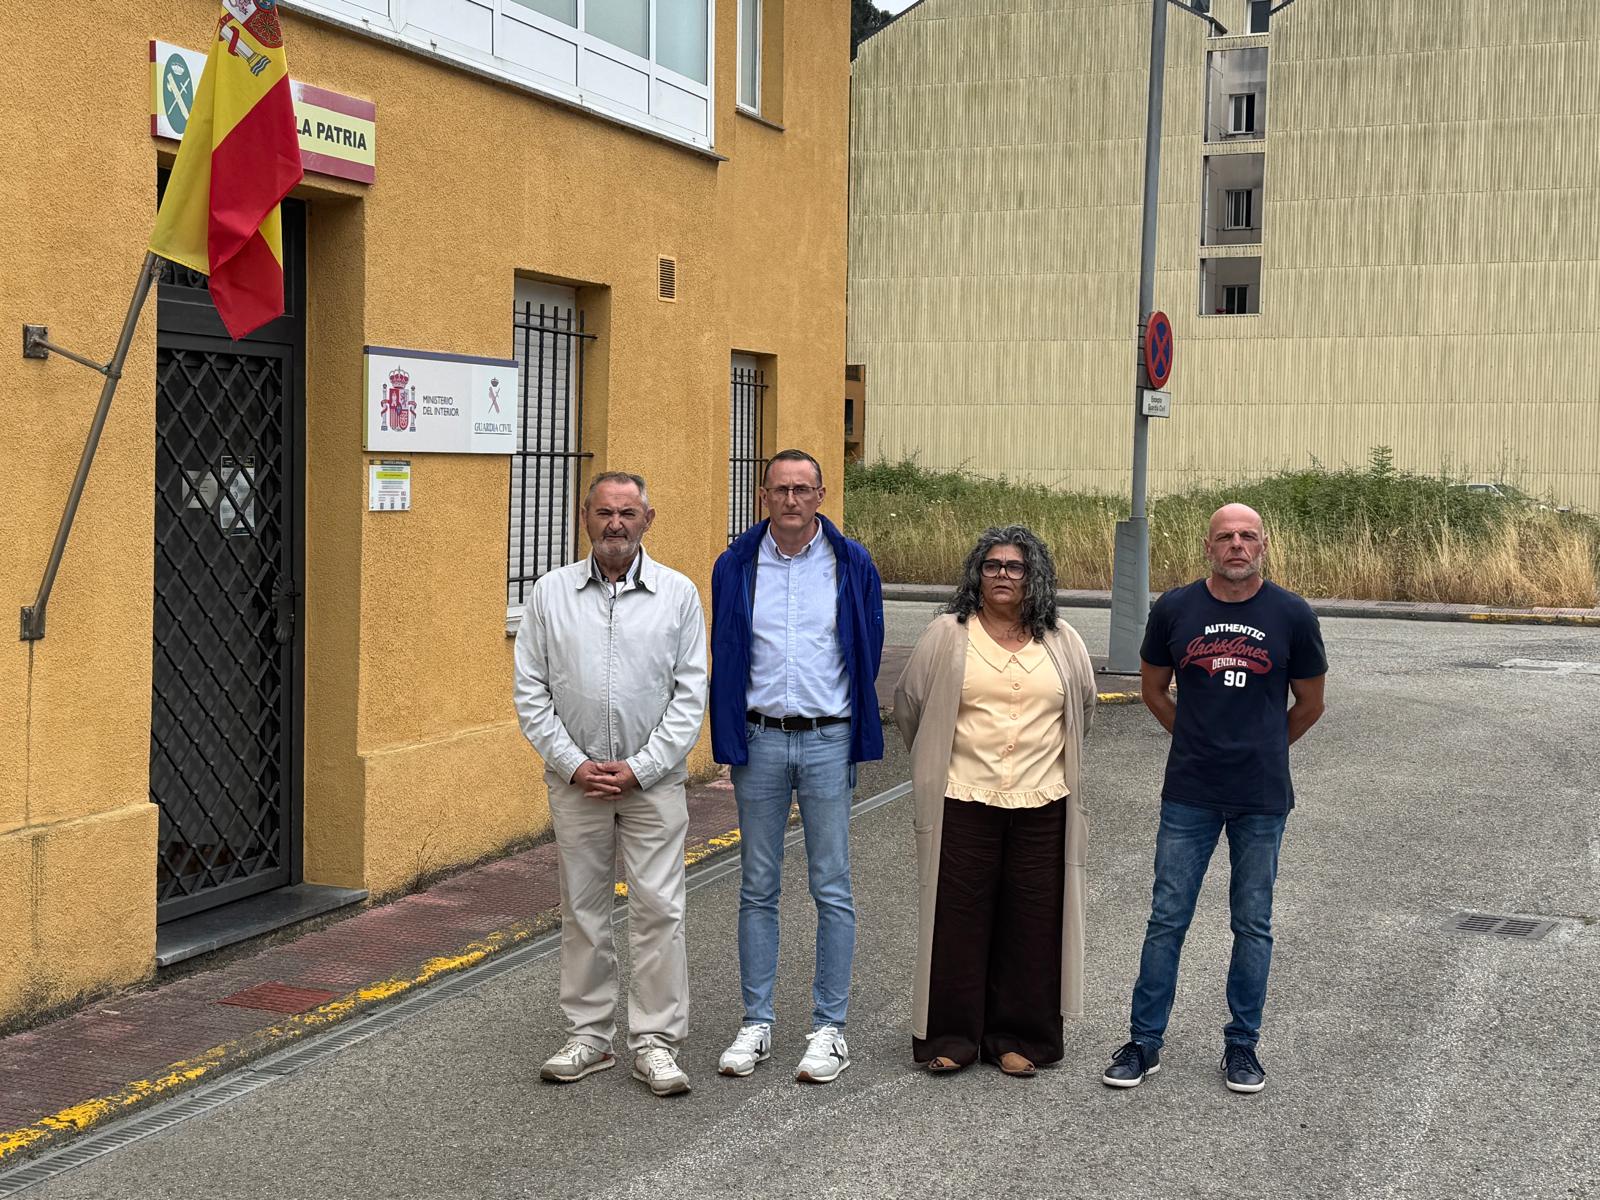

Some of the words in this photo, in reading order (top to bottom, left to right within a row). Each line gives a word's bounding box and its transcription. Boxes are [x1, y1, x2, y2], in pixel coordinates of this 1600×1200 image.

[294, 116, 312, 137] LA
[317, 121, 368, 150] PATRIA
[422, 395, 454, 405] MINISTERIO
[422, 406, 434, 415] DEL
[434, 407, 460, 416] INTERIOR
[474, 422, 499, 432] GUARDIA
[499, 423, 513, 433] CIVIL
[1204, 623, 1266, 641] AUTHENTIC
[1212, 657, 1236, 670] DENIM
[1223, 670, 1247, 688] 90
